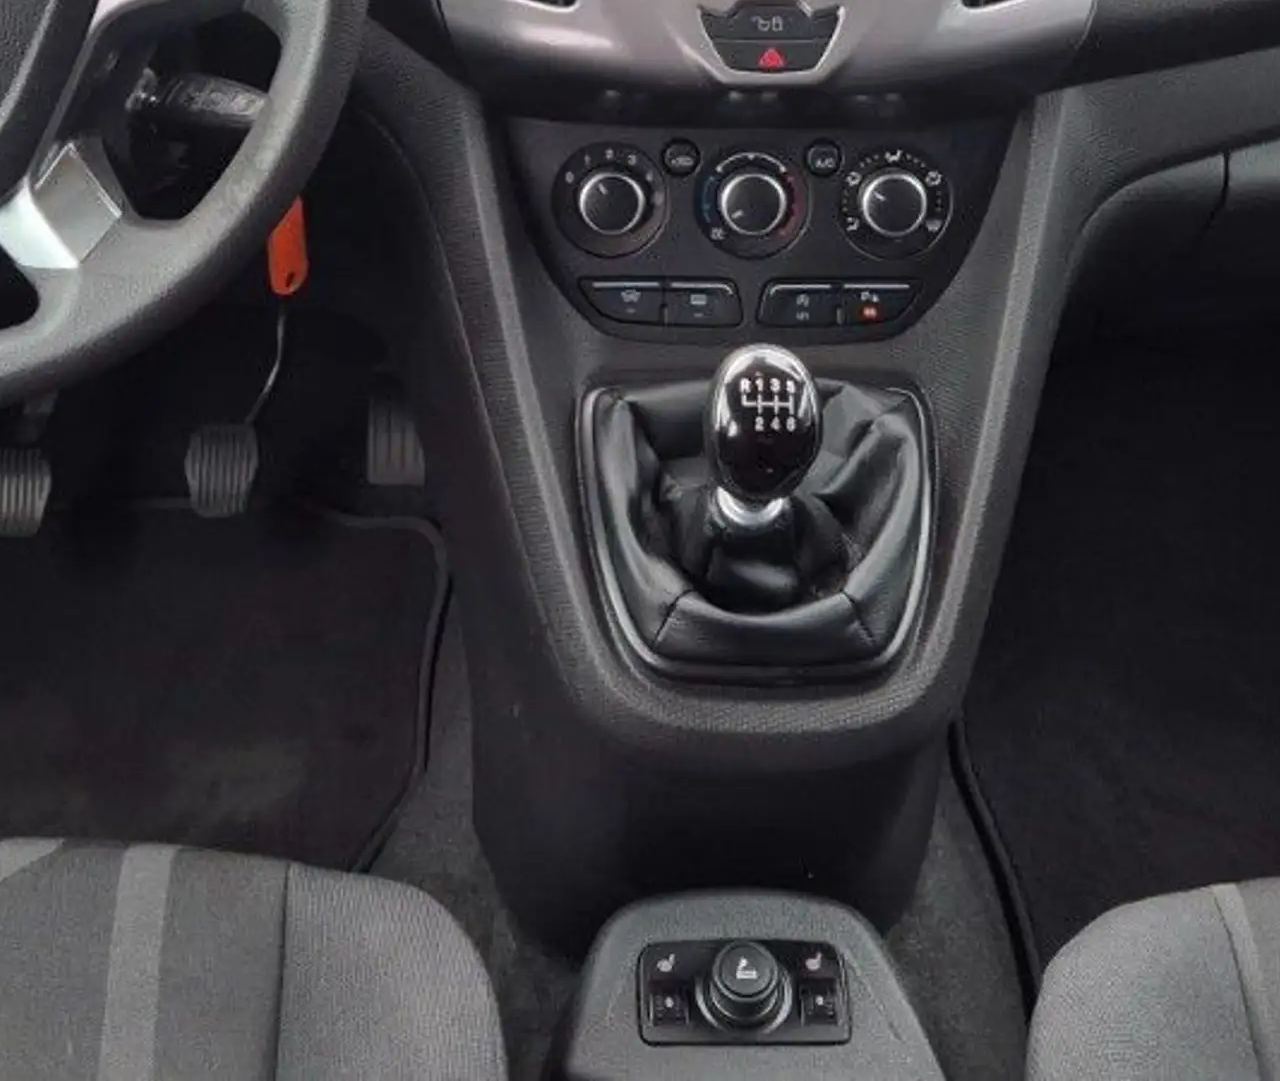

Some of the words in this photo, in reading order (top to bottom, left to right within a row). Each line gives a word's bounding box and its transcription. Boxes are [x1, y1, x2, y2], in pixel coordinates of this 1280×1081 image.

[769, 378, 781, 393] 3
[754, 417, 765, 432] 2
[769, 417, 781, 432] 4
